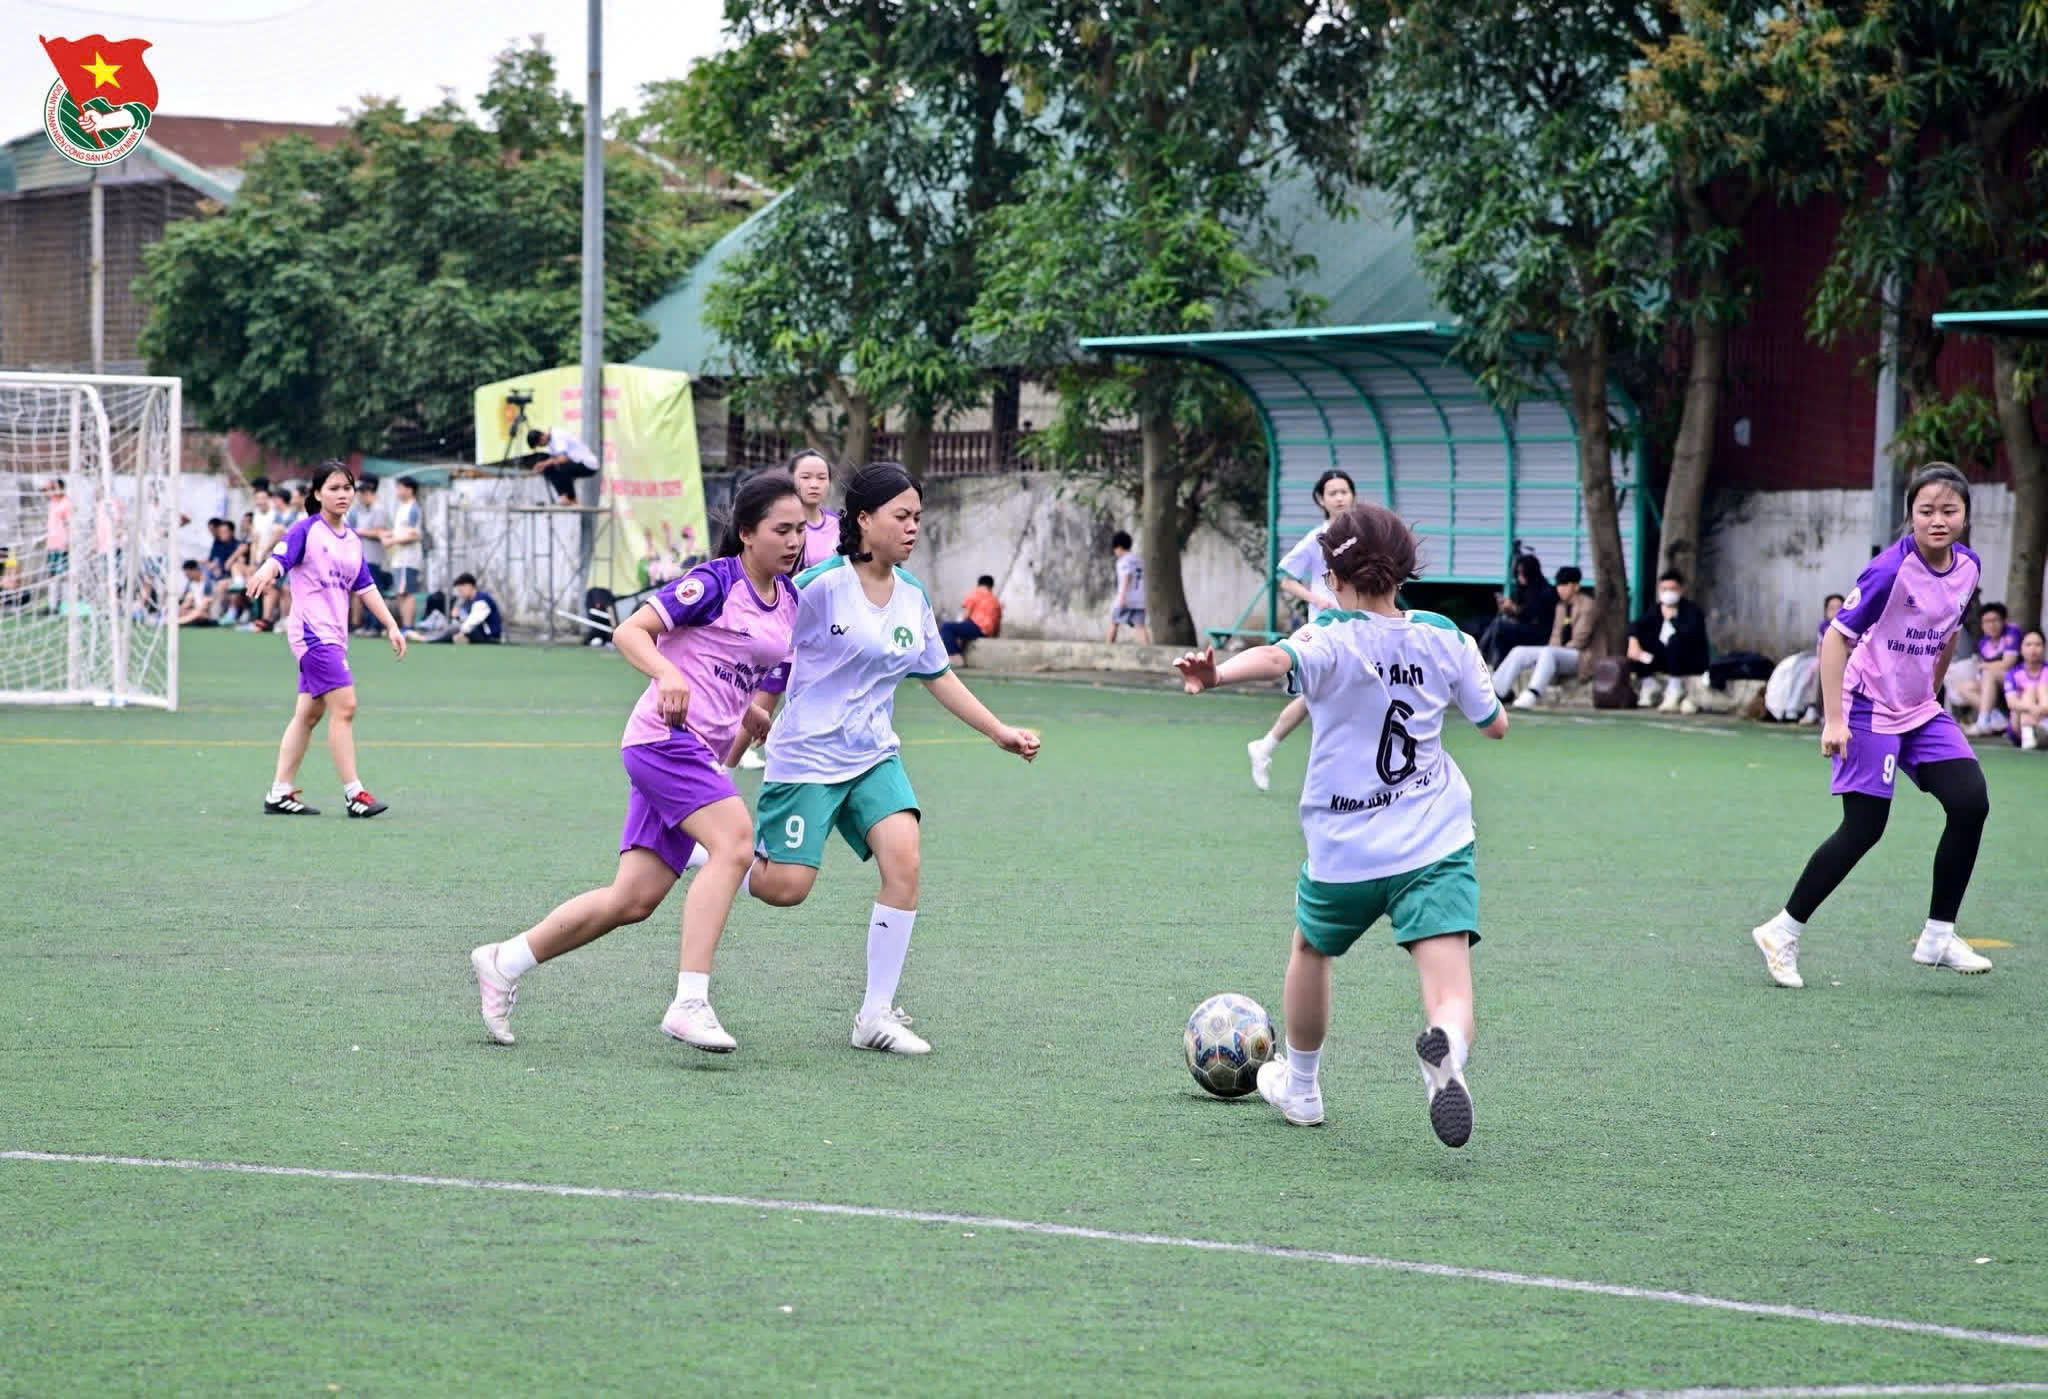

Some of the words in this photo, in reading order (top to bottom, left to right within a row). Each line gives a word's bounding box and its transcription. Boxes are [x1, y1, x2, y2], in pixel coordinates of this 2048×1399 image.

[1389, 663, 1424, 687] Anh
[1376, 699, 1417, 786] 6
[1882, 753, 1896, 785] 9
[784, 815, 806, 849] 9
